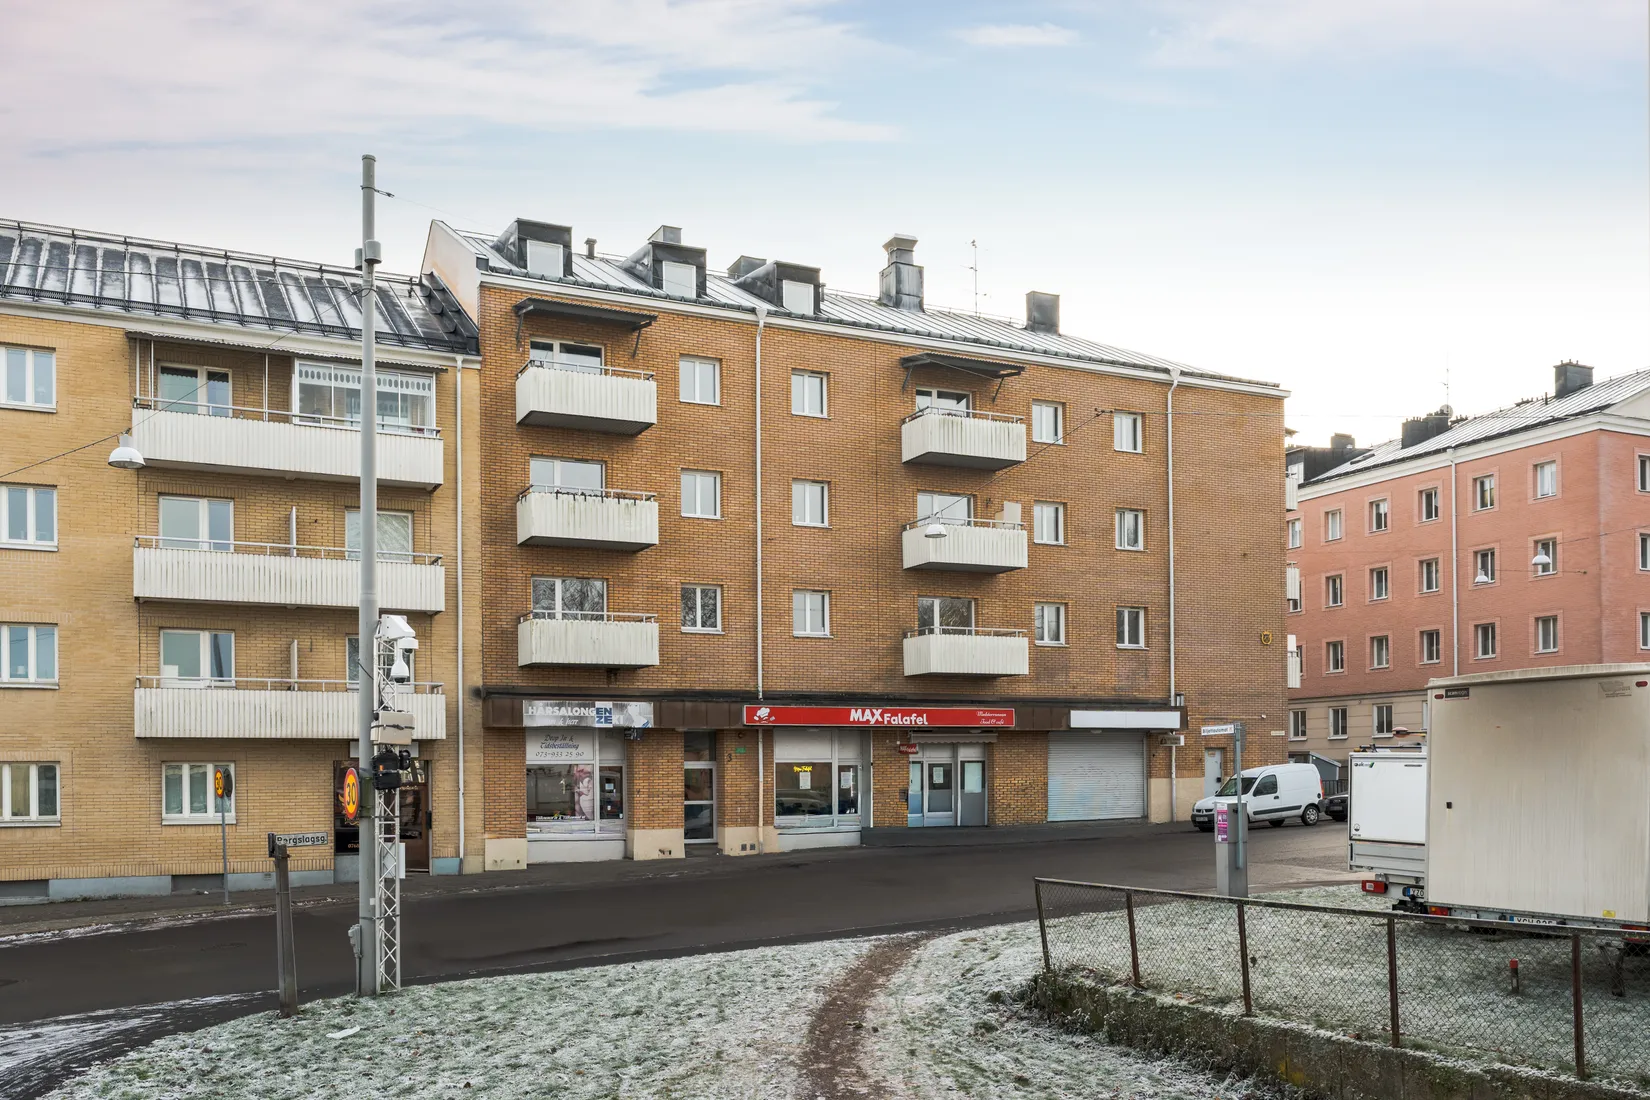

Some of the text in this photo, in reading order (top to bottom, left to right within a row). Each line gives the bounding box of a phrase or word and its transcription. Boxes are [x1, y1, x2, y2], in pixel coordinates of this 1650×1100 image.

[596, 715, 624, 725] ZEKI
[850, 708, 928, 725] MAX Falafel
[346, 782, 356, 806] 30
